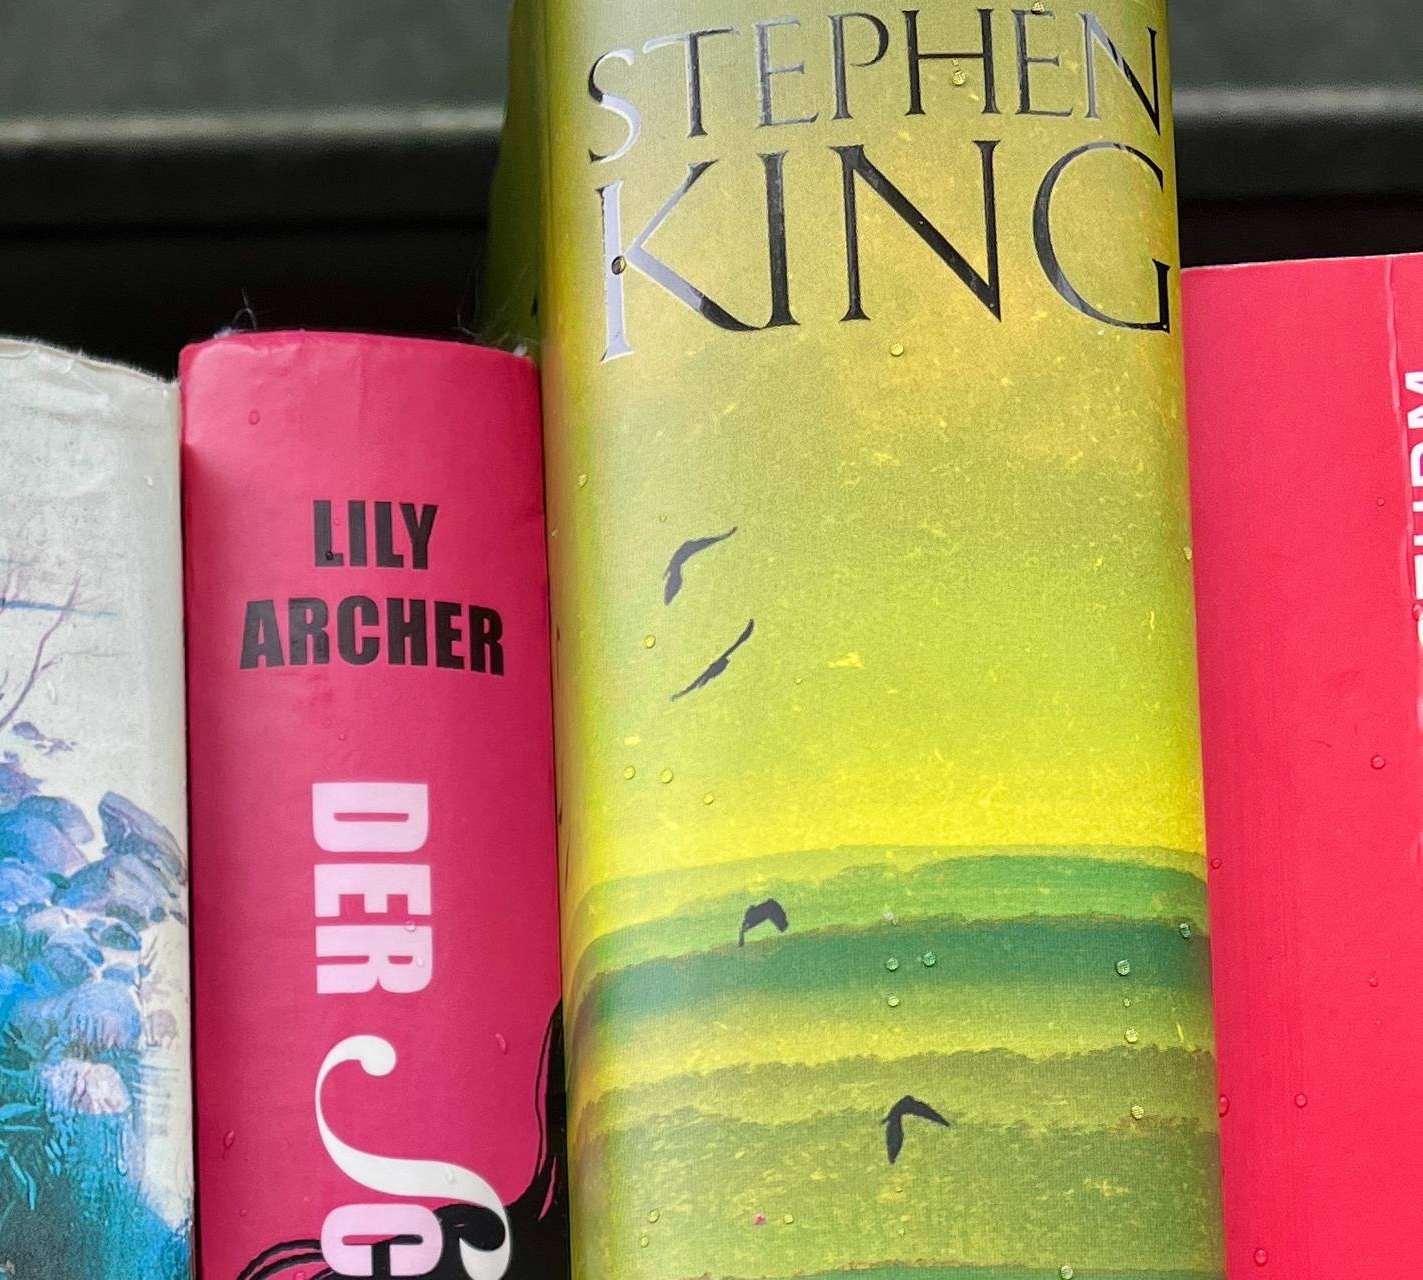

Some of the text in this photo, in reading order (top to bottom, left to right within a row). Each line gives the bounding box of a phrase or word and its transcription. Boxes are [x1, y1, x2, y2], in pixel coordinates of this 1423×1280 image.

[587, 8, 1162, 163] STEPHEN
[593, 140, 1171, 362] KING
[312, 499, 438, 571] LILY
[239, 597, 504, 675] ARCHER
[312, 782, 433, 995] DER
